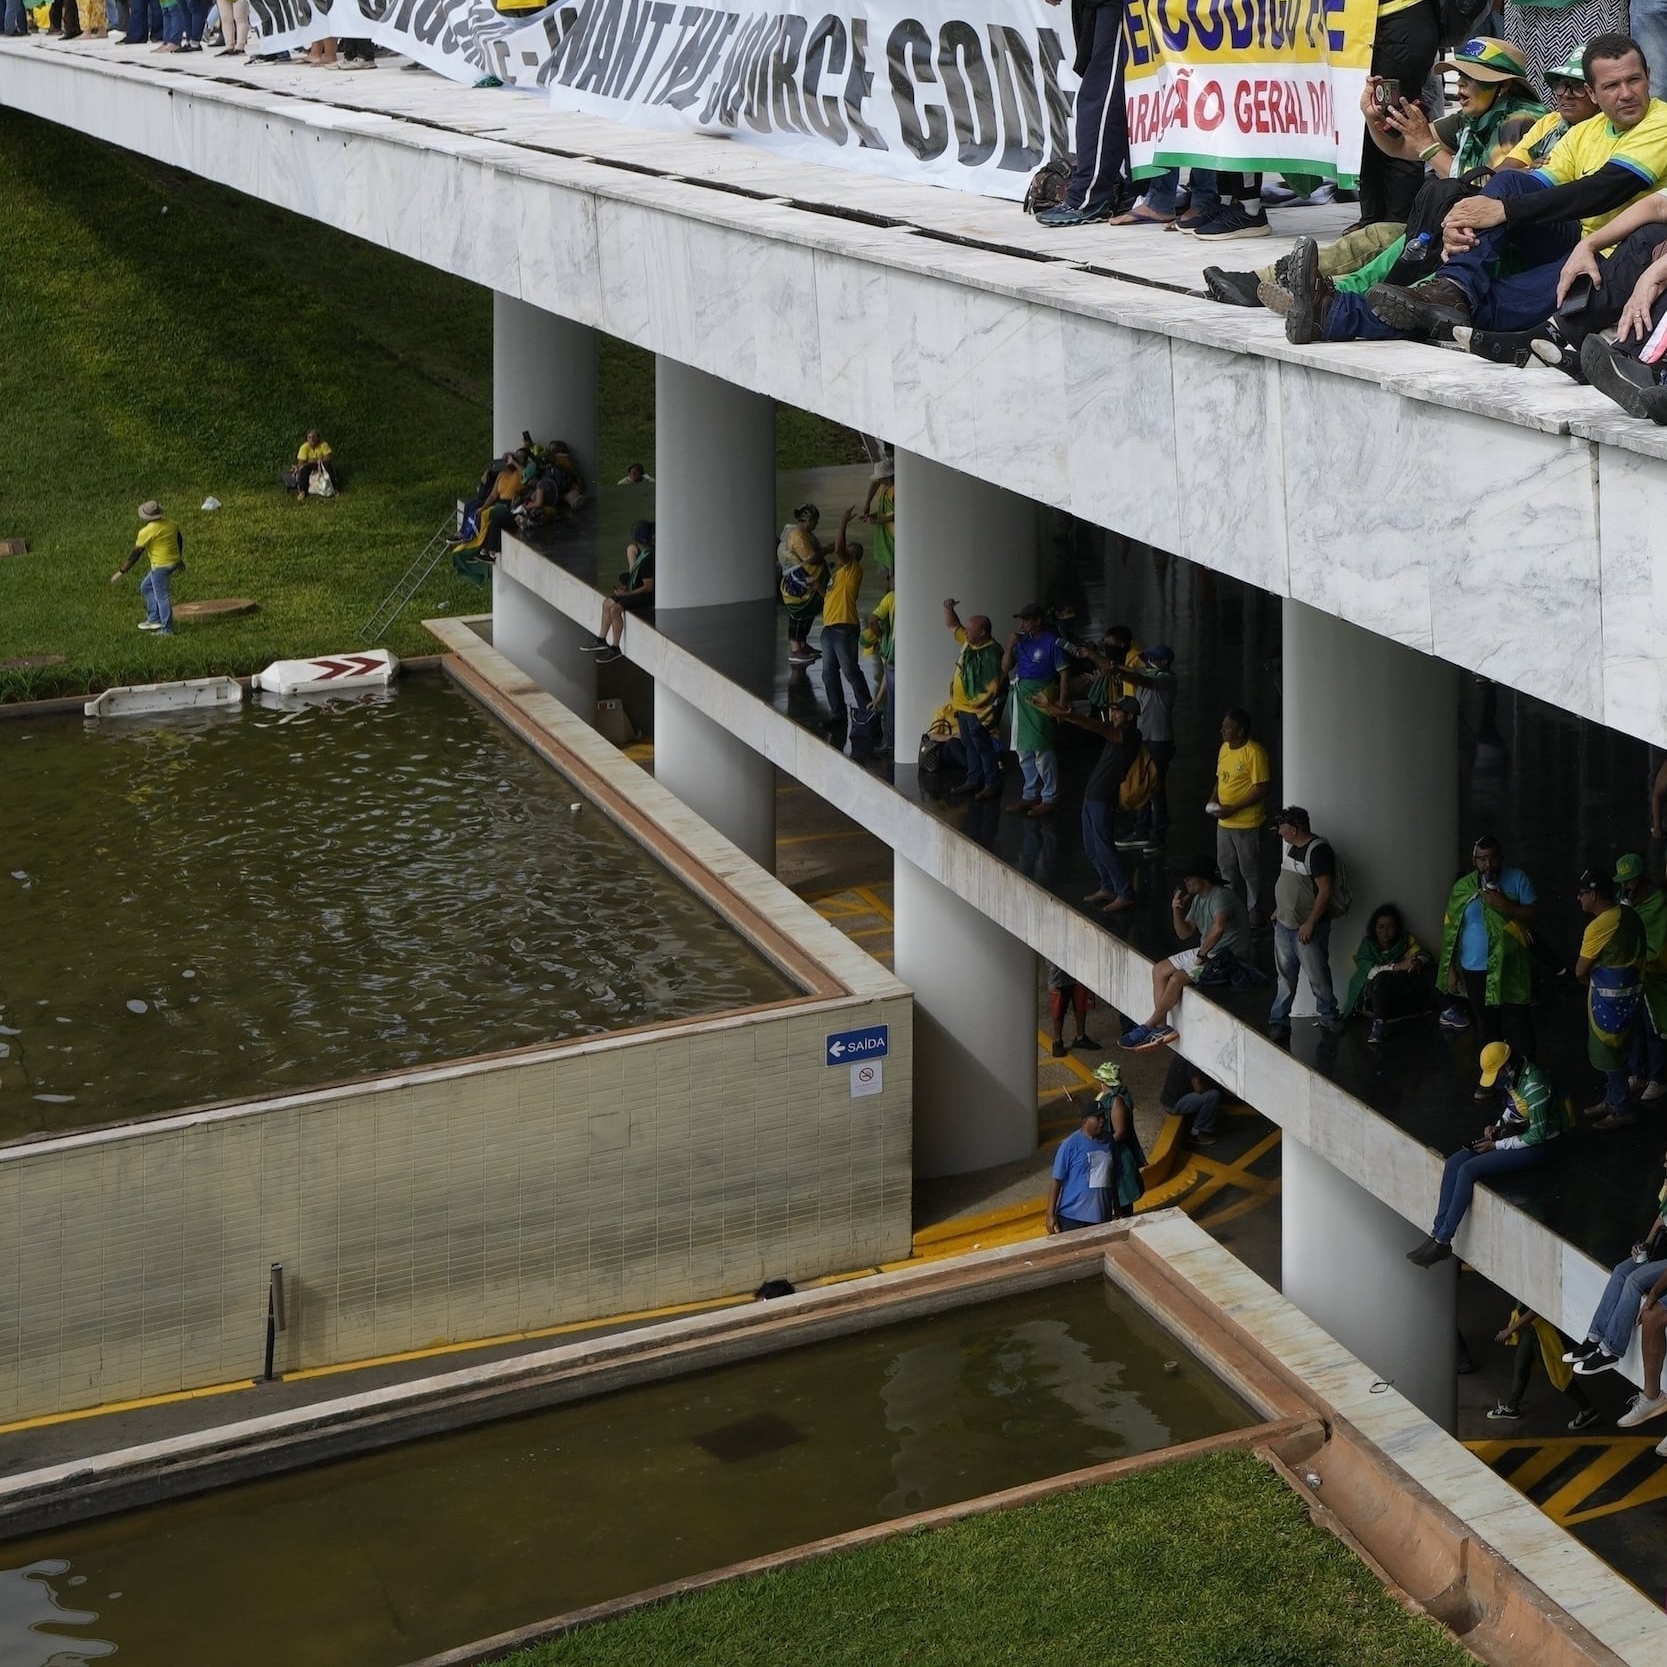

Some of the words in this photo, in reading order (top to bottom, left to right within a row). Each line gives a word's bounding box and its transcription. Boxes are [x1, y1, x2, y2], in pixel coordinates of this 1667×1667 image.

[643, 5, 740, 111] THE
[699, 12, 889, 152] SOURCE
[886, 18, 1078, 172] CODE
[1234, 79, 1308, 135] GERAL
[847, 1037, 886, 1053] SAÍDA
